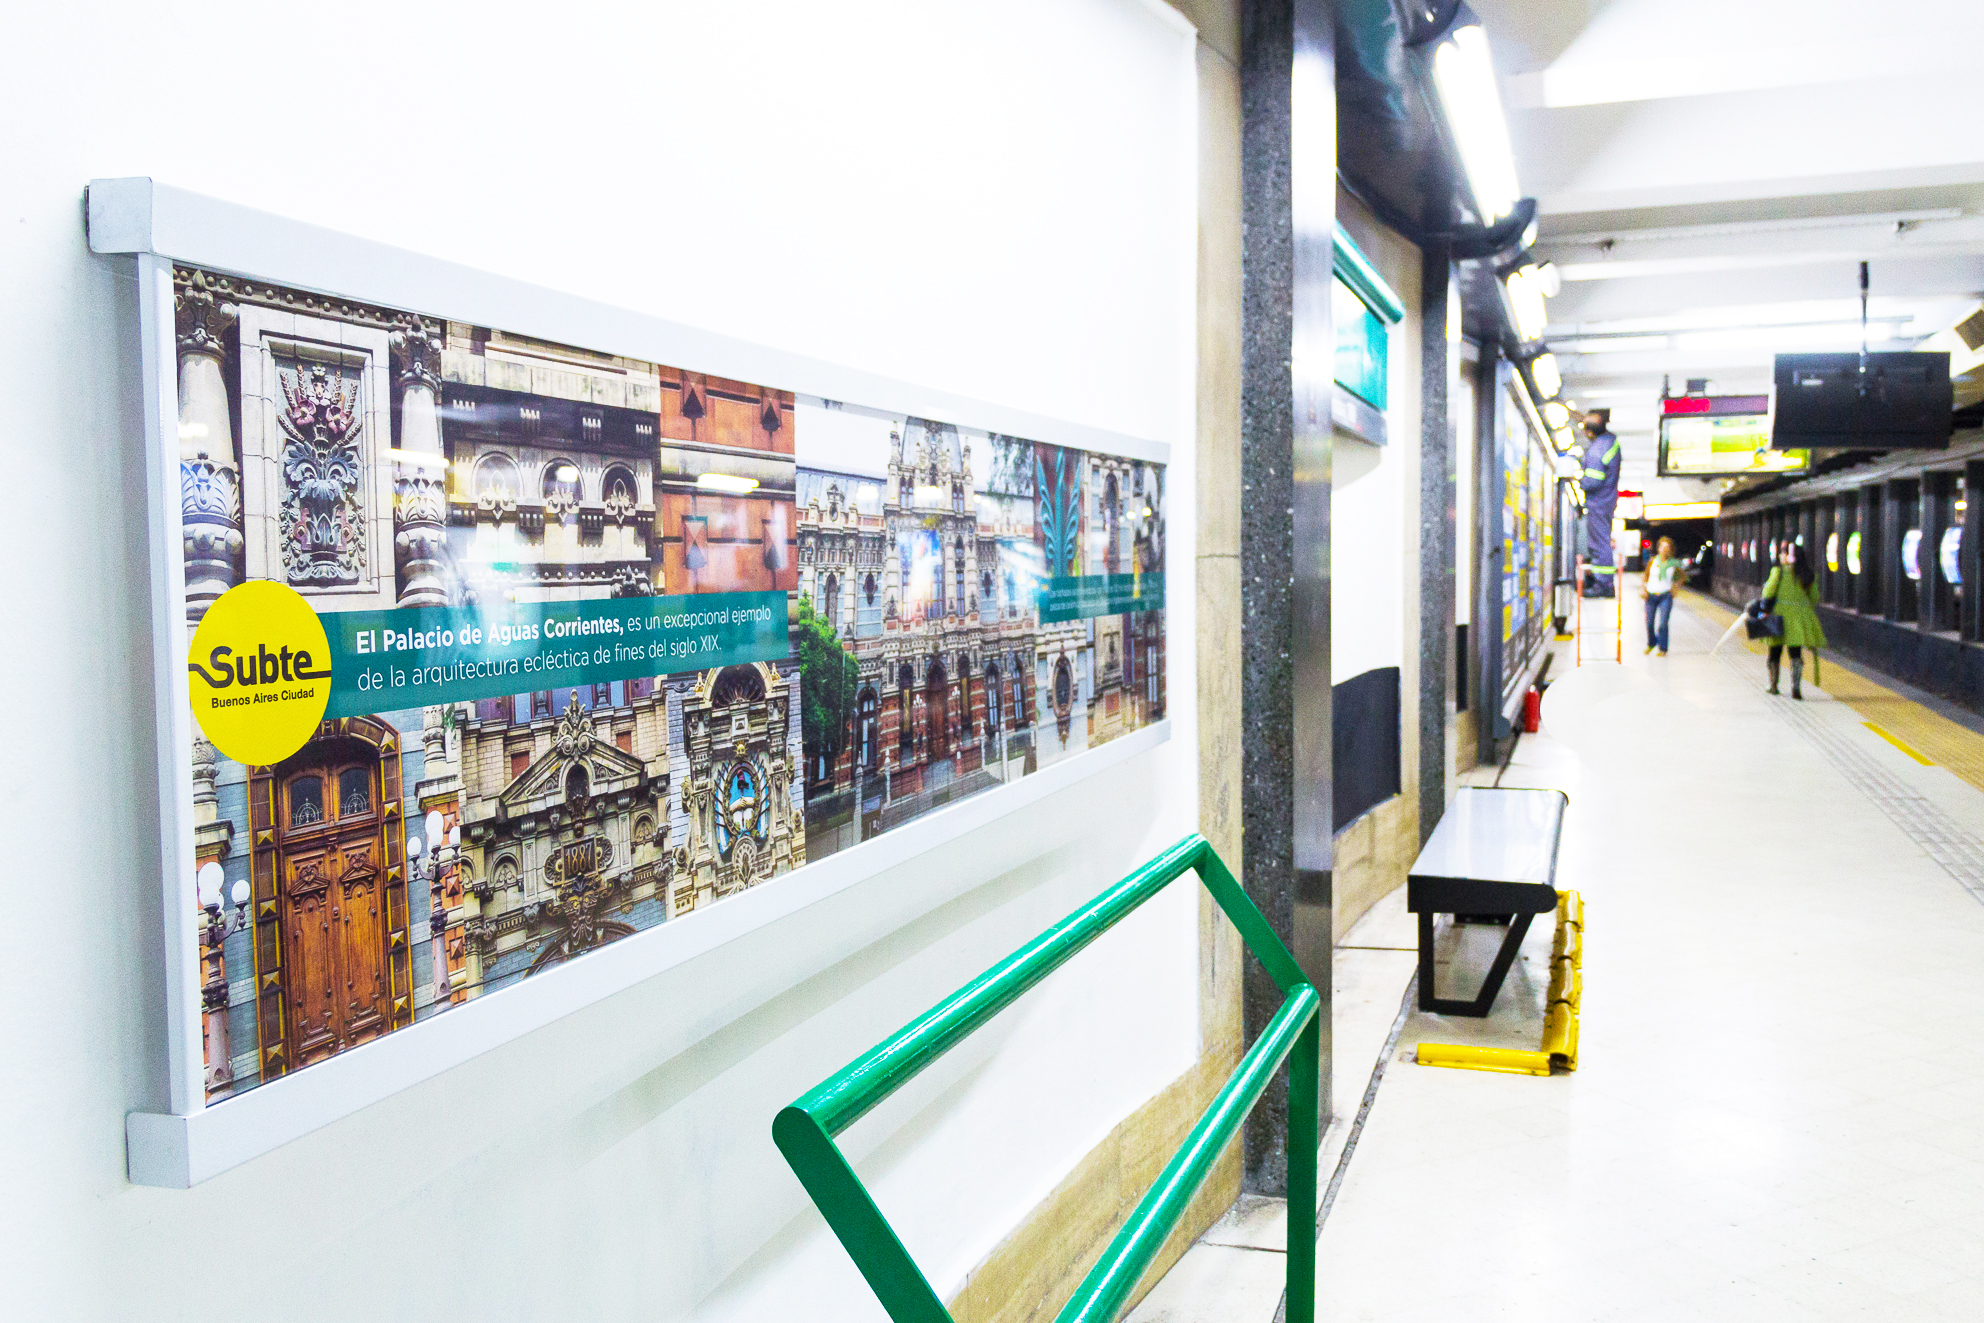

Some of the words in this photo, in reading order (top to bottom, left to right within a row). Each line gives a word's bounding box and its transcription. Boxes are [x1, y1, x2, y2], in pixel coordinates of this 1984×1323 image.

[356, 629, 376, 654] El
[383, 625, 454, 652] Palacio
[459, 624, 482, 645] de
[488, 622, 539, 646] Aguas
[544, 616, 624, 638] Corrientes,
[627, 617, 641, 632] es
[645, 615, 661, 631] un
[664, 607, 729, 630] excepcional
[731, 604, 771, 627] ejemplo
[196, 643, 321, 689] Subte
[357, 667, 383, 691] de
[390, 665, 406, 687] la
[412, 657, 519, 687] arquitectura
[523, 648, 590, 673] ecléctica
[593, 644, 611, 665] de
[615, 643, 645, 662] fines
[648, 638, 667, 658] del
[670, 636, 697, 658] siglo
[700, 634, 722, 653] XIX.
[211, 695, 251, 709] Buenos
[253, 692, 279, 704] Aires
[281, 687, 315, 700] Ciudad
[565, 841, 592, 876] 1887
